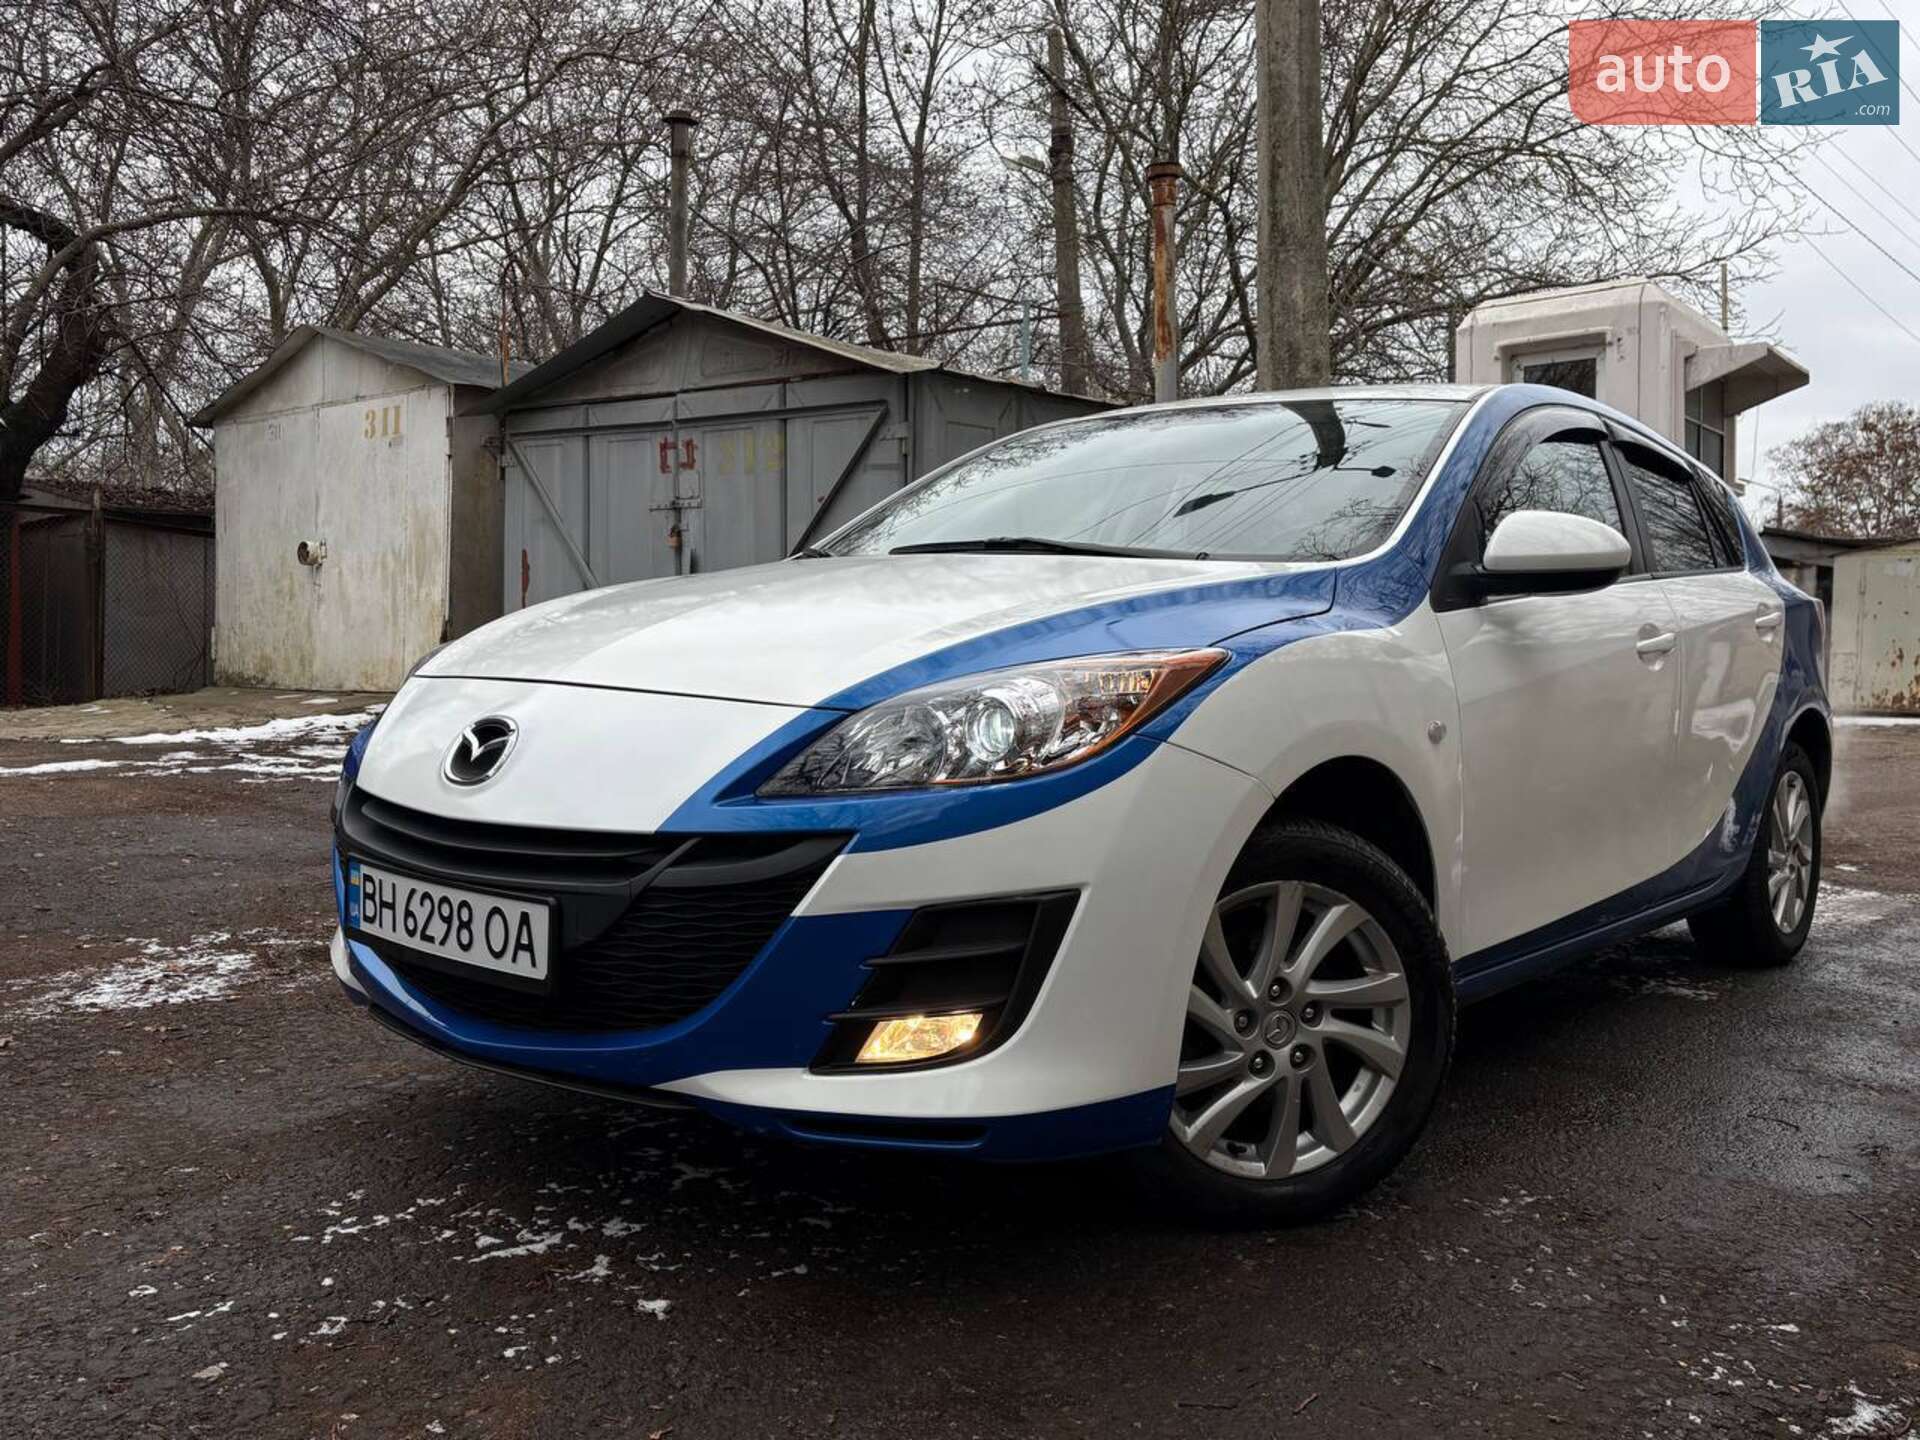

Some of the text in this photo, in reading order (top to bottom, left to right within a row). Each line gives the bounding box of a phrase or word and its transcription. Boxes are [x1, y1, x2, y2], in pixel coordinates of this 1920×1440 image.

[362, 872, 397, 933] BH
[403, 887, 474, 952] 6298
[484, 905, 538, 969] OA
